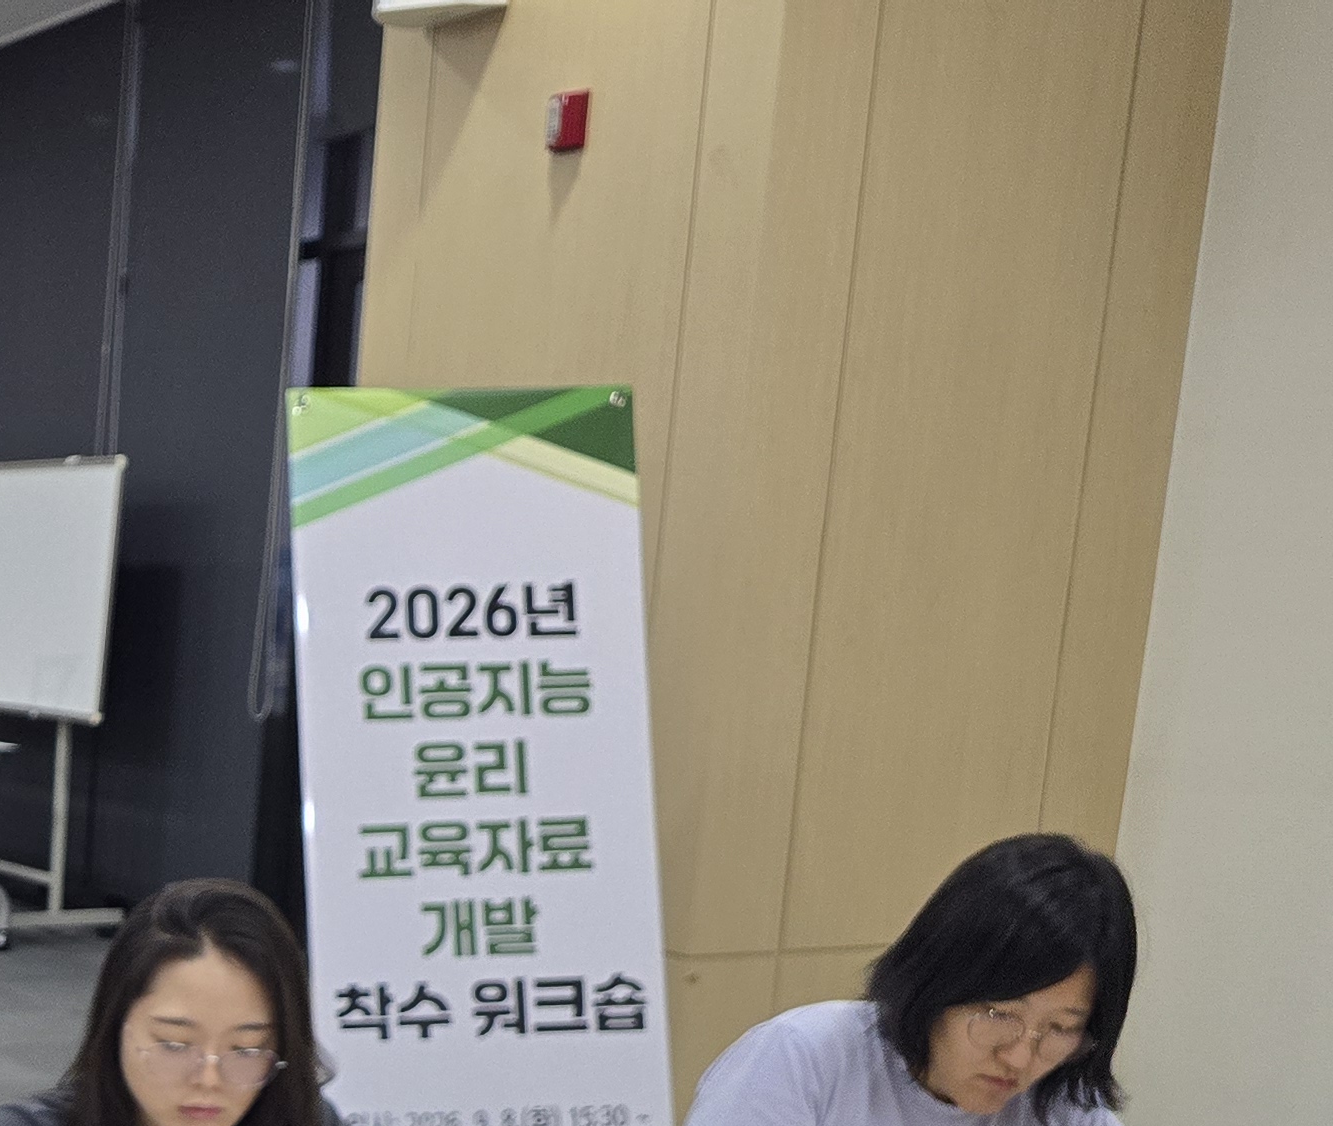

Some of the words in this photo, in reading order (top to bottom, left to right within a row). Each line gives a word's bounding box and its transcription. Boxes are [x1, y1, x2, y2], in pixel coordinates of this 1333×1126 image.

[366, 580, 579, 641] 2026년
[359, 659, 594, 722] 인공지능
[413, 738, 530, 799] 윤리
[357, 815, 594, 881] 교육자료
[421, 895, 539, 959] 개발
[336, 982, 454, 1041] 착수
[472, 972, 648, 1037] 워크숍
